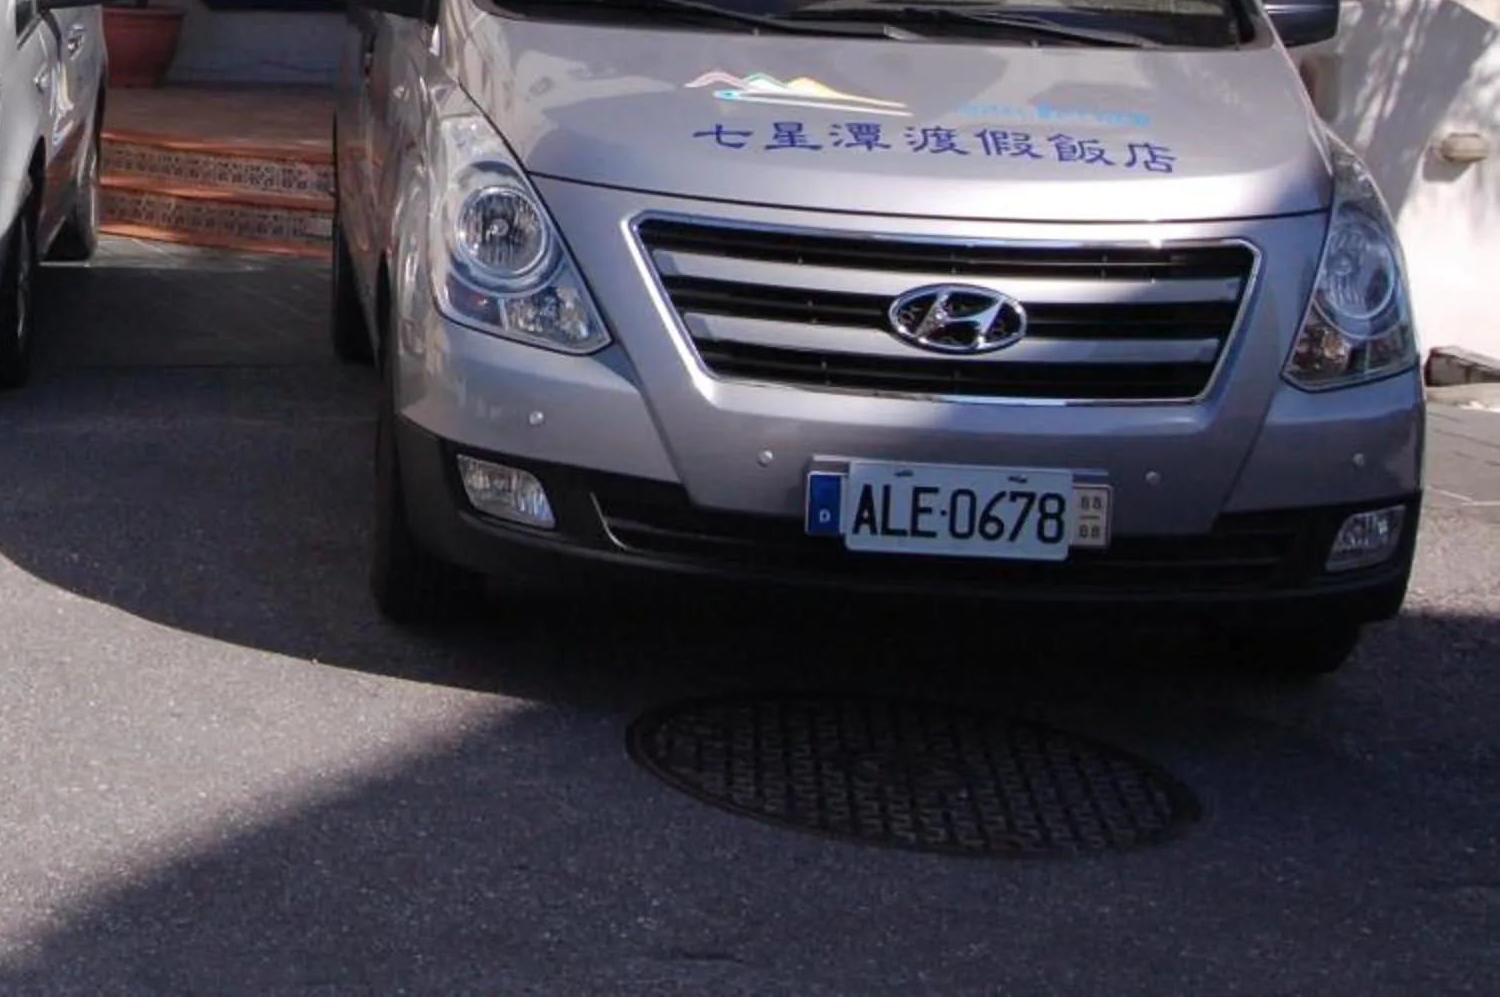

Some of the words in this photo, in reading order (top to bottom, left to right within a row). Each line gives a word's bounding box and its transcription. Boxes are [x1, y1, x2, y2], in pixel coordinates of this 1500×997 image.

[691, 120, 1176, 174] 七星潭渡假飯店
